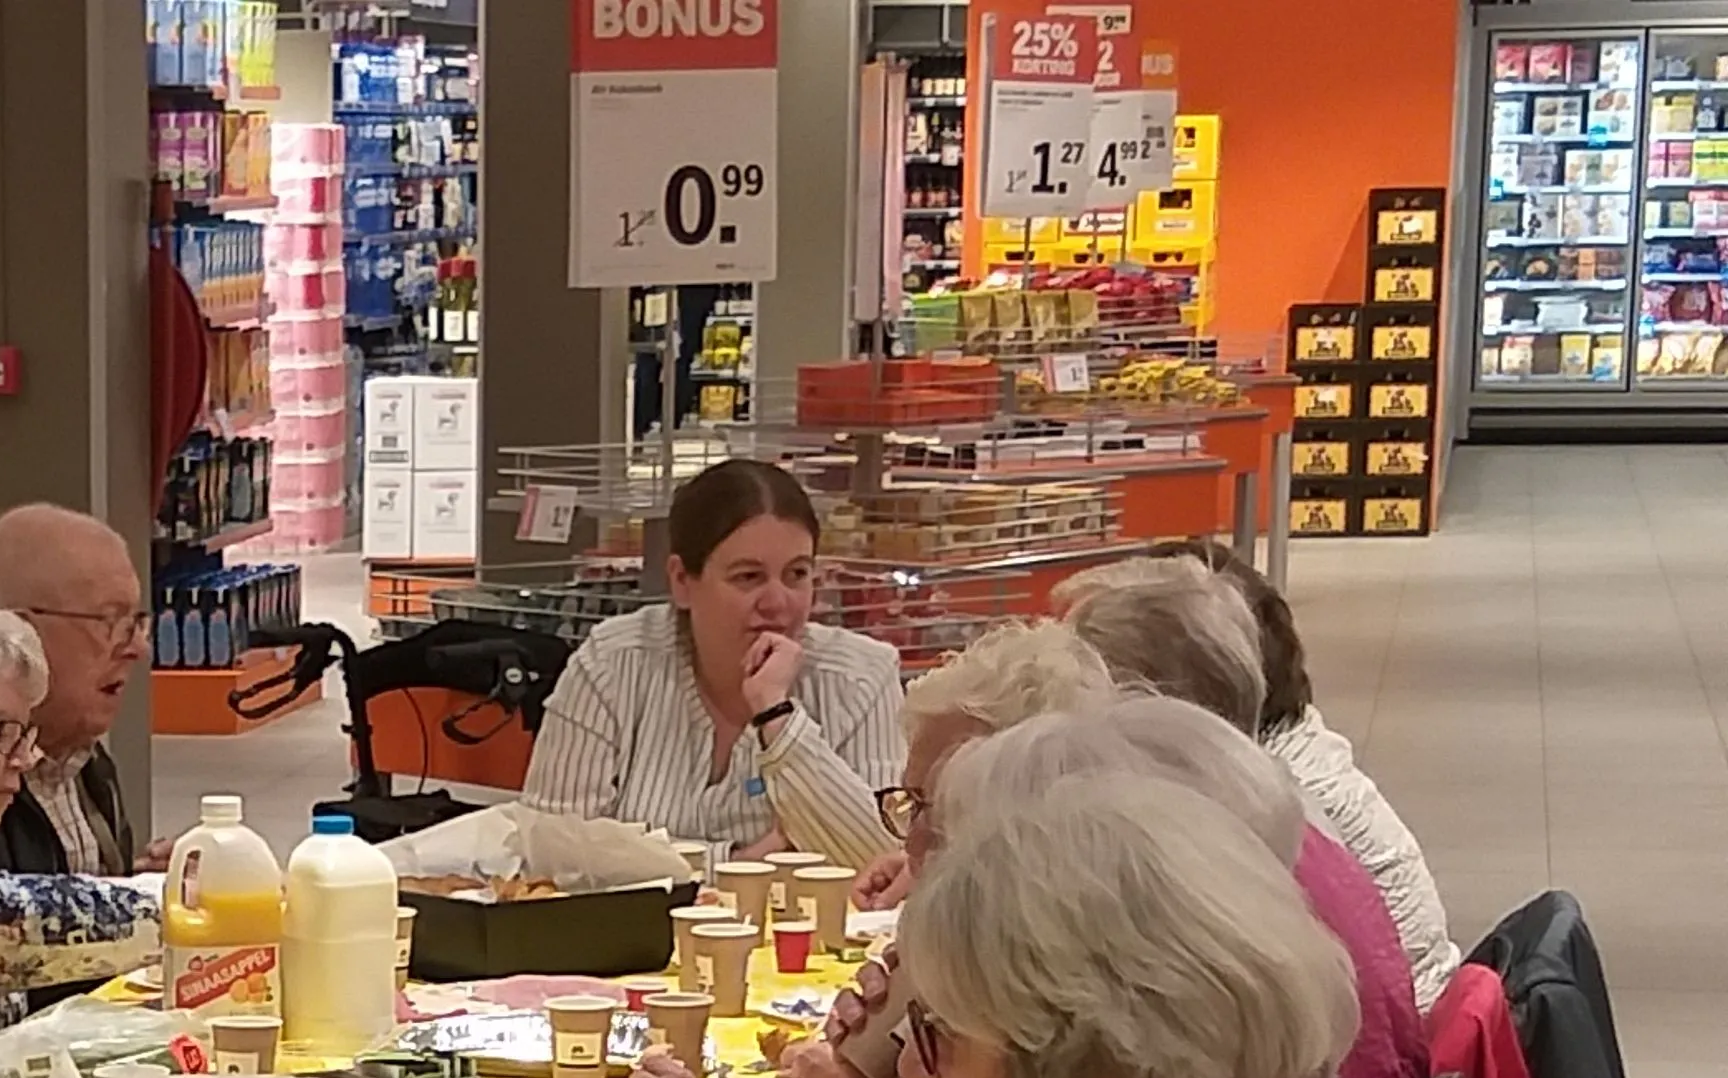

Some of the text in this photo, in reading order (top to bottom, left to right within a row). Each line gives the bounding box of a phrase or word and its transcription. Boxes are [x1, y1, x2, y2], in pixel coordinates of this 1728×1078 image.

[593, 0, 765, 38] BONUS
[1011, 21, 1078, 58] 25%
[665, 164, 764, 246] 0.99
